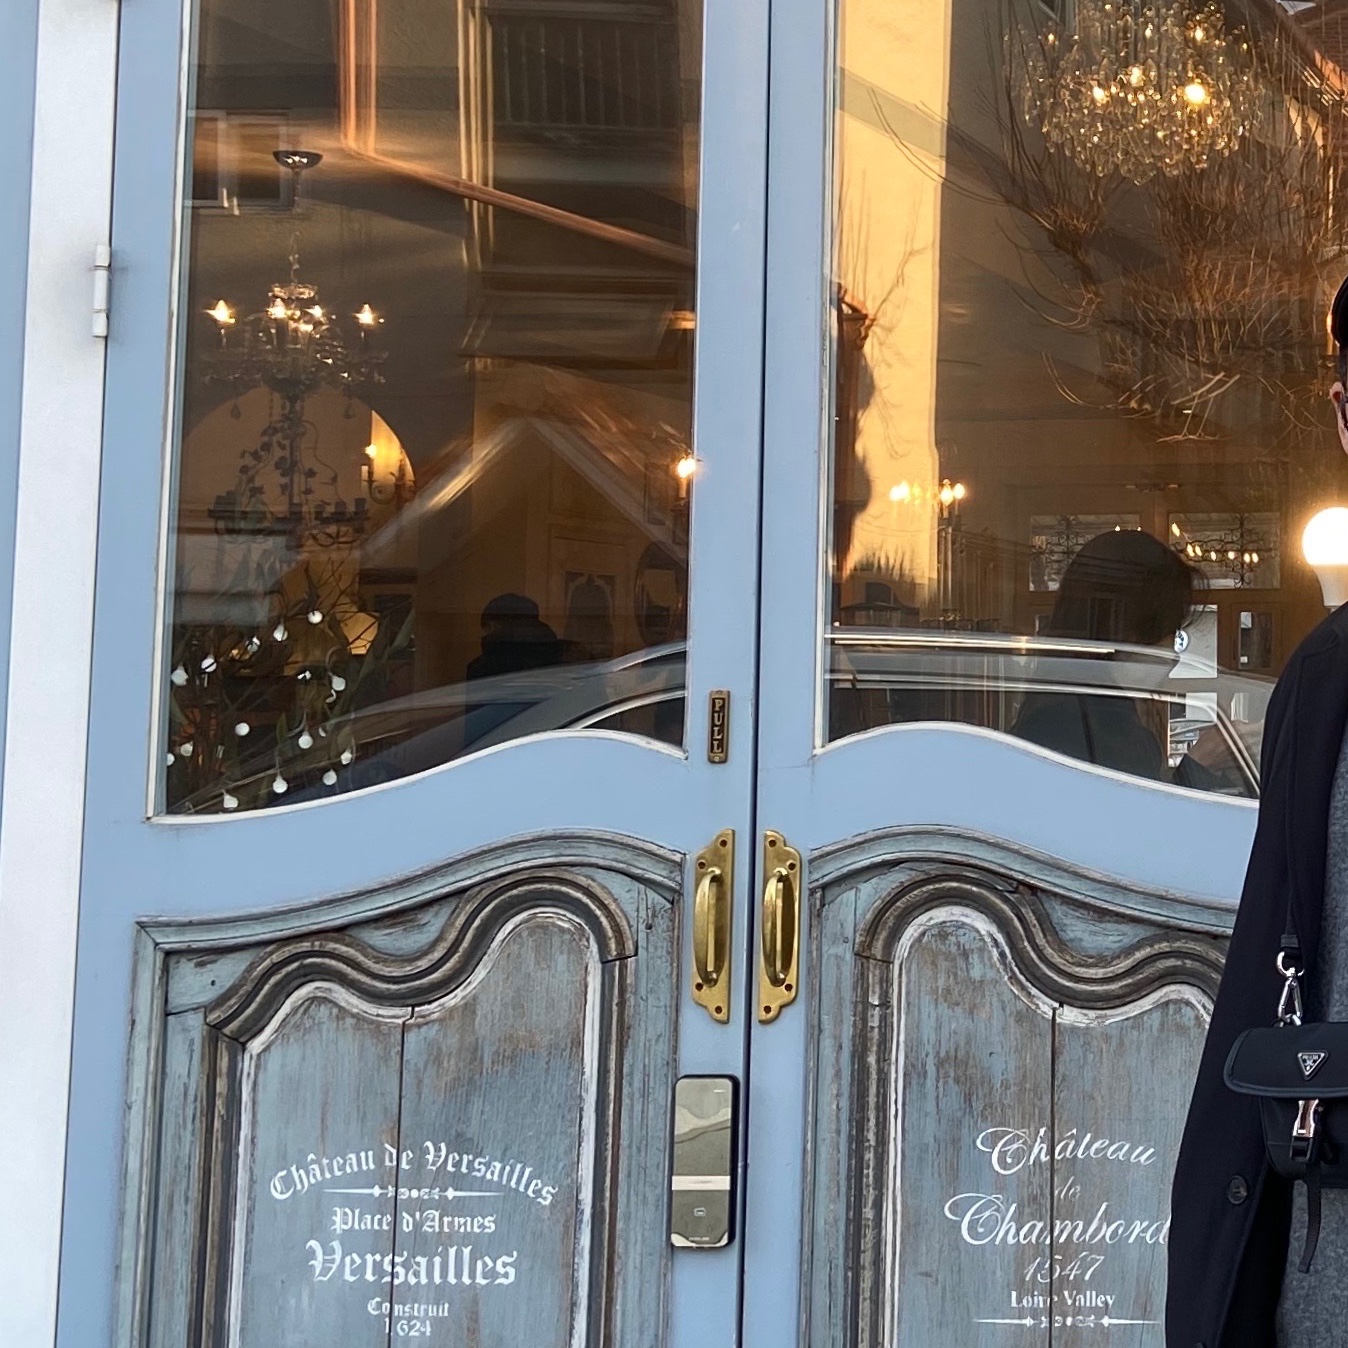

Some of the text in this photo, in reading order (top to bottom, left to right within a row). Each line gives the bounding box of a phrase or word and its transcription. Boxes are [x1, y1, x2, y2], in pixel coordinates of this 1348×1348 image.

[712, 699, 724, 753] PULL
[976, 1126, 1158, 1176] Château
[270, 1140, 559, 1206] Château de Versailles
[331, 1207, 497, 1235] Place d'Armes
[305, 1239, 519, 1286] Versailles
[1023, 1251, 1106, 1283] 1547
[367, 1297, 450, 1317] Construit
[1010, 1290, 1116, 1309] Loire Valley
[384, 1317, 432, 1337] 1624
